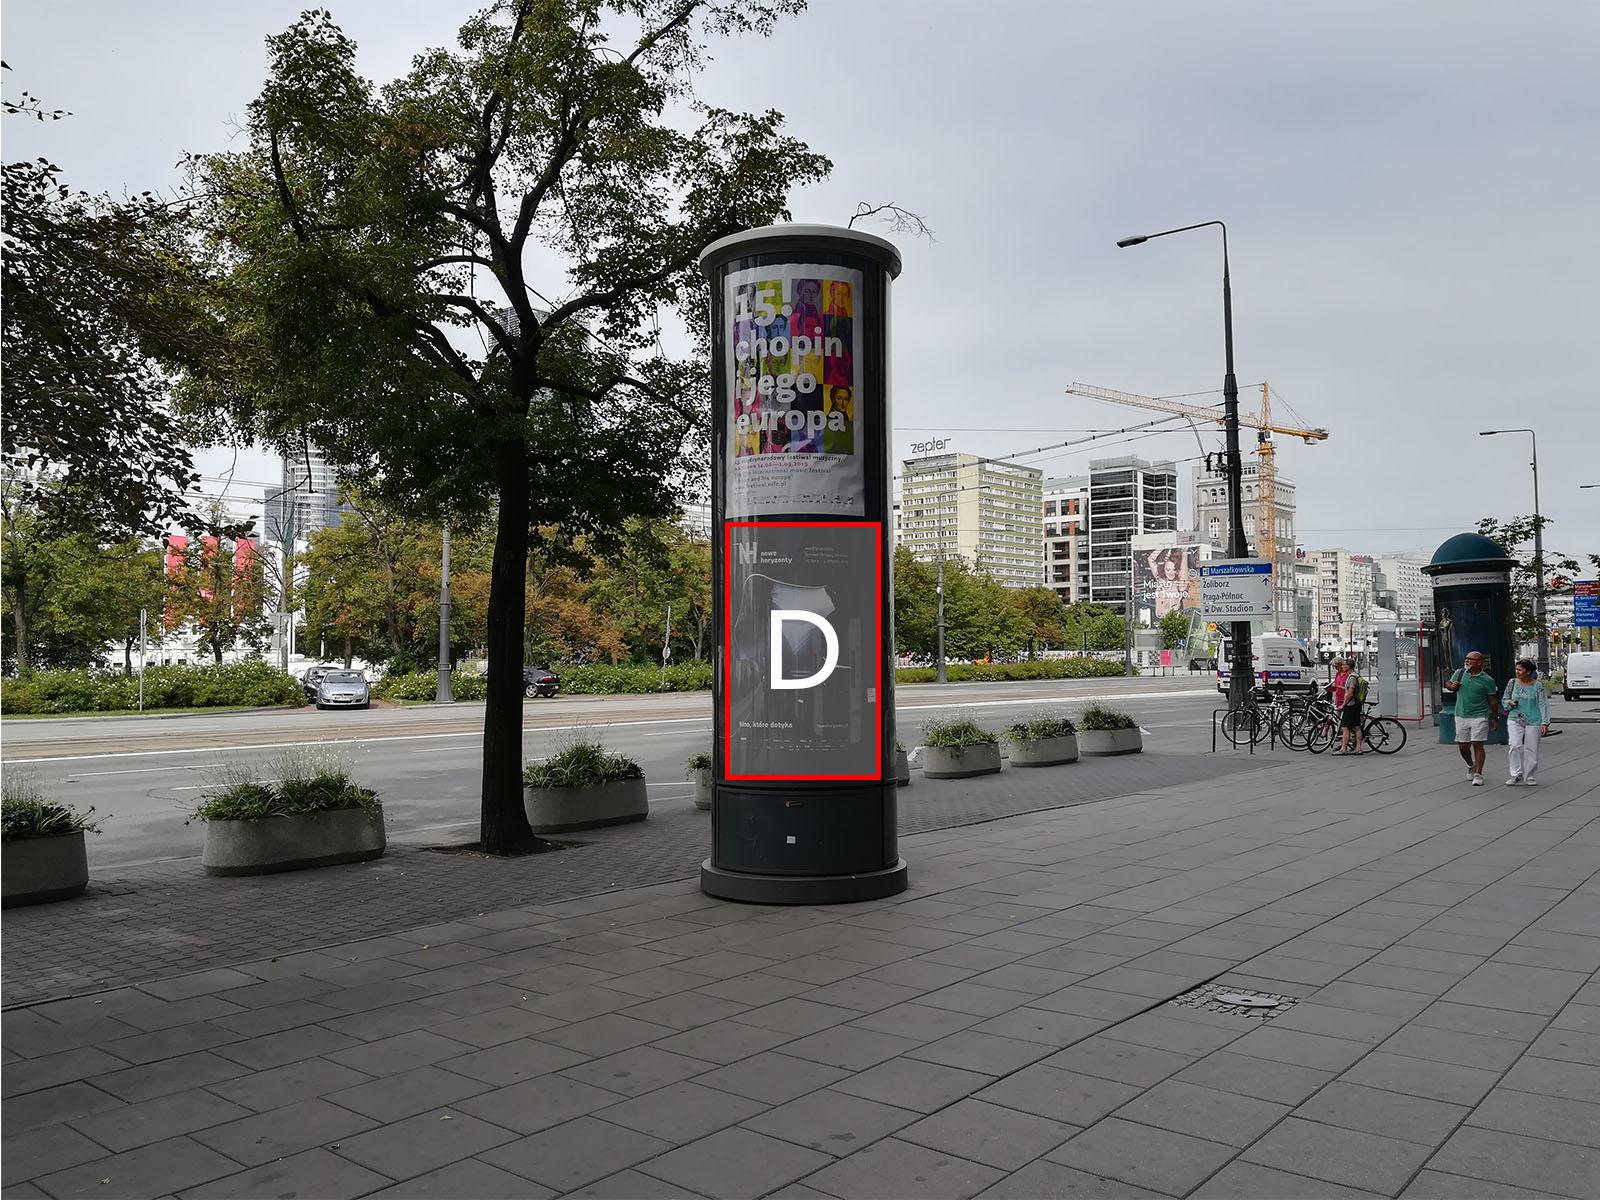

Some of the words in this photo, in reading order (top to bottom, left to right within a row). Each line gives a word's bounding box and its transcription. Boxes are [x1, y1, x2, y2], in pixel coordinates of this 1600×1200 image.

[736, 326, 842, 364] chopin
[735, 369, 742, 399] i
[746, 367, 816, 406] jego
[736, 409, 846, 440] europa
[910, 436, 951, 456] zepter
[760, 557, 793, 565] horyzonty
[1143, 579, 1173, 589] Miasto
[1142, 590, 1159, 602] jest
[1211, 605, 1224, 613] Dw.
[1225, 604, 1254, 613] Stadion
[770, 721, 793, 729] dotyka
